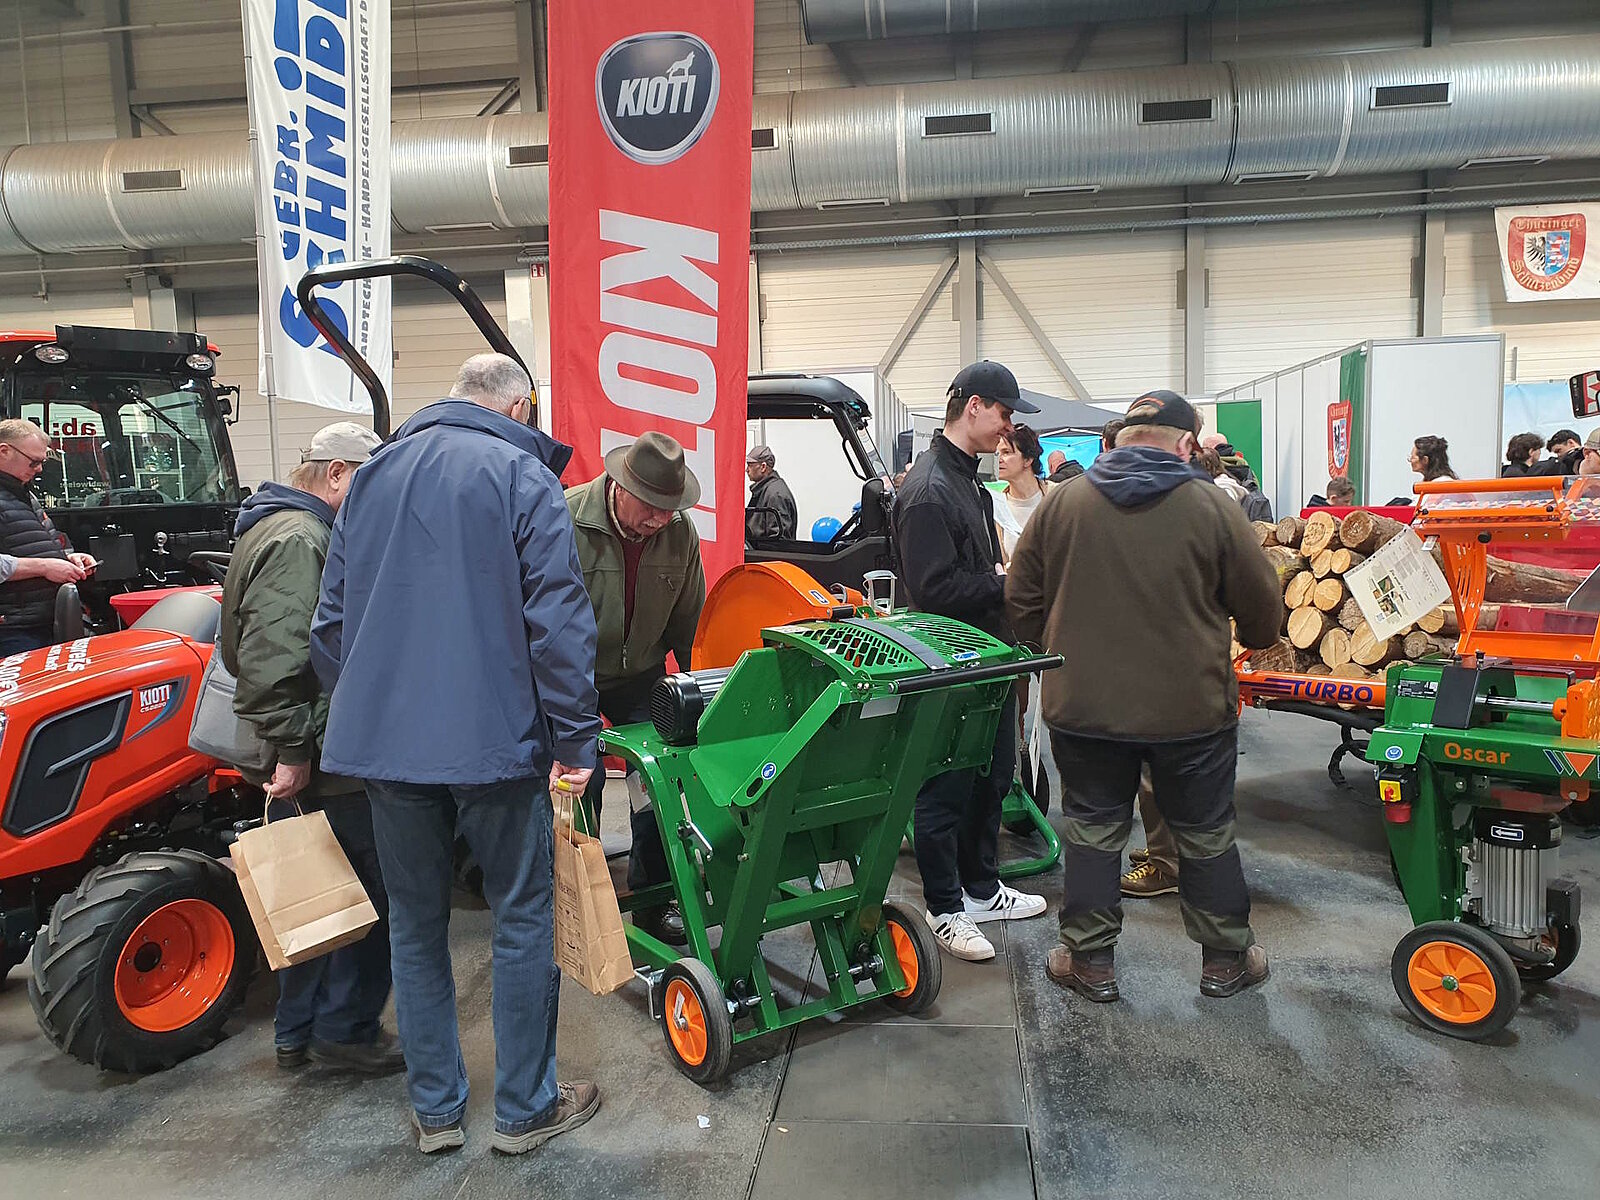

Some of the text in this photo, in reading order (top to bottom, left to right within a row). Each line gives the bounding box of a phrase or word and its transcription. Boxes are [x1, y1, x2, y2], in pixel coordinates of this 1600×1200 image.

[616, 74, 697, 117] KIOTI
[360, 13, 371, 229] HANDELSGESELLSCHAFT
[599, 208, 719, 542] KIOT
[140, 684, 170, 707] KIOTI
[1294, 680, 1374, 703] TURBO
[1444, 742, 1511, 765] Oscar
